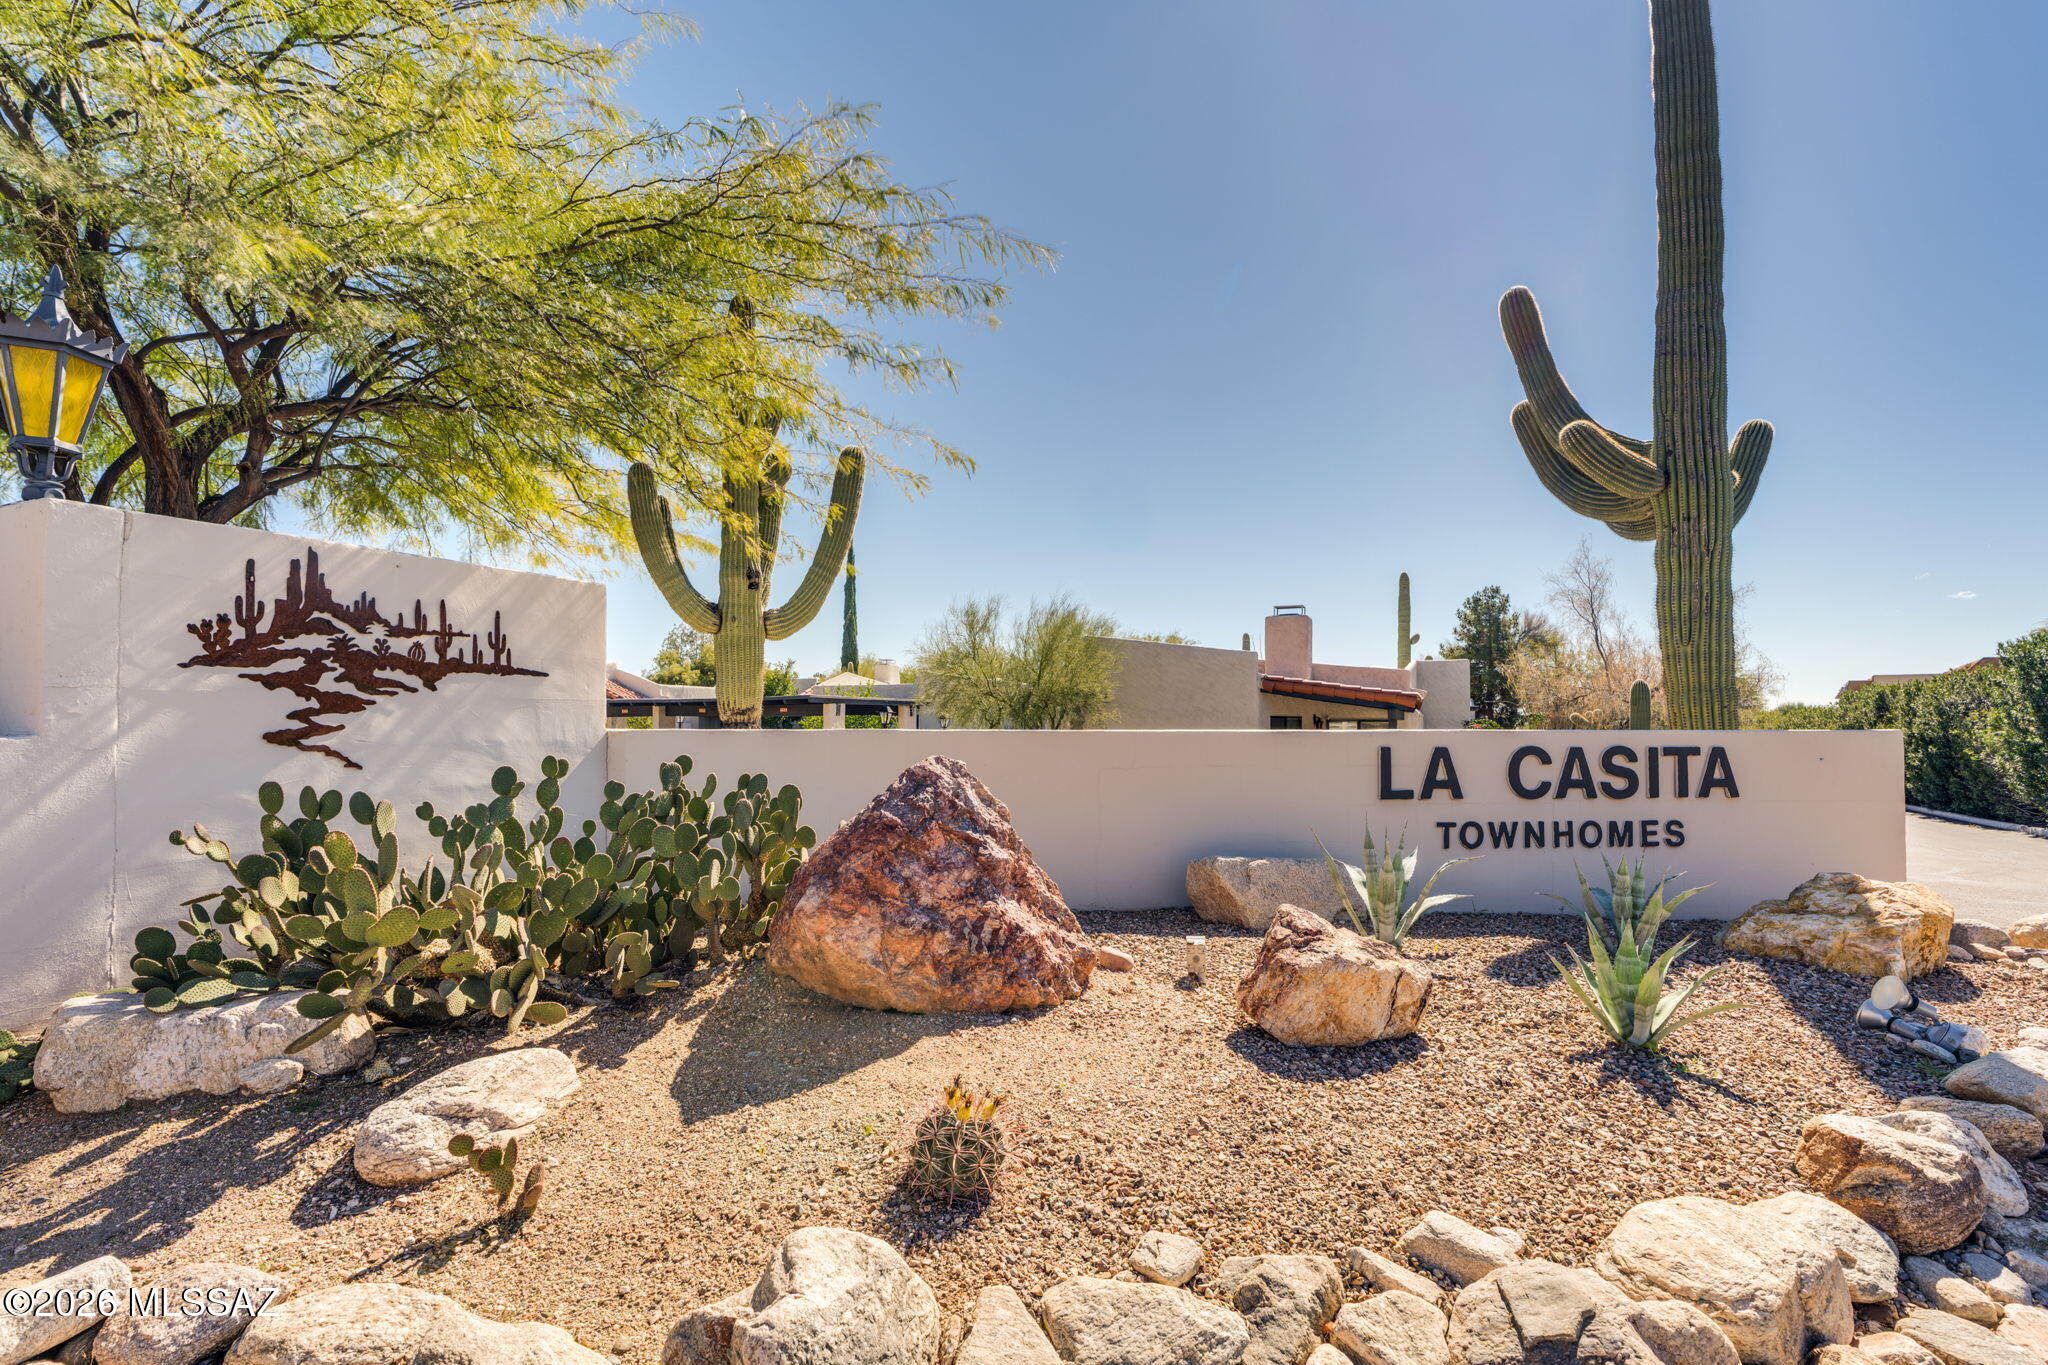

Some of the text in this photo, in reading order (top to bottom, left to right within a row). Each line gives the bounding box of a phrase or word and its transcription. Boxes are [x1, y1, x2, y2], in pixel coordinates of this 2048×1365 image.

[1378, 745, 1740, 800] LA CASITA
[1436, 819, 1686, 850] TOWNHOMES
